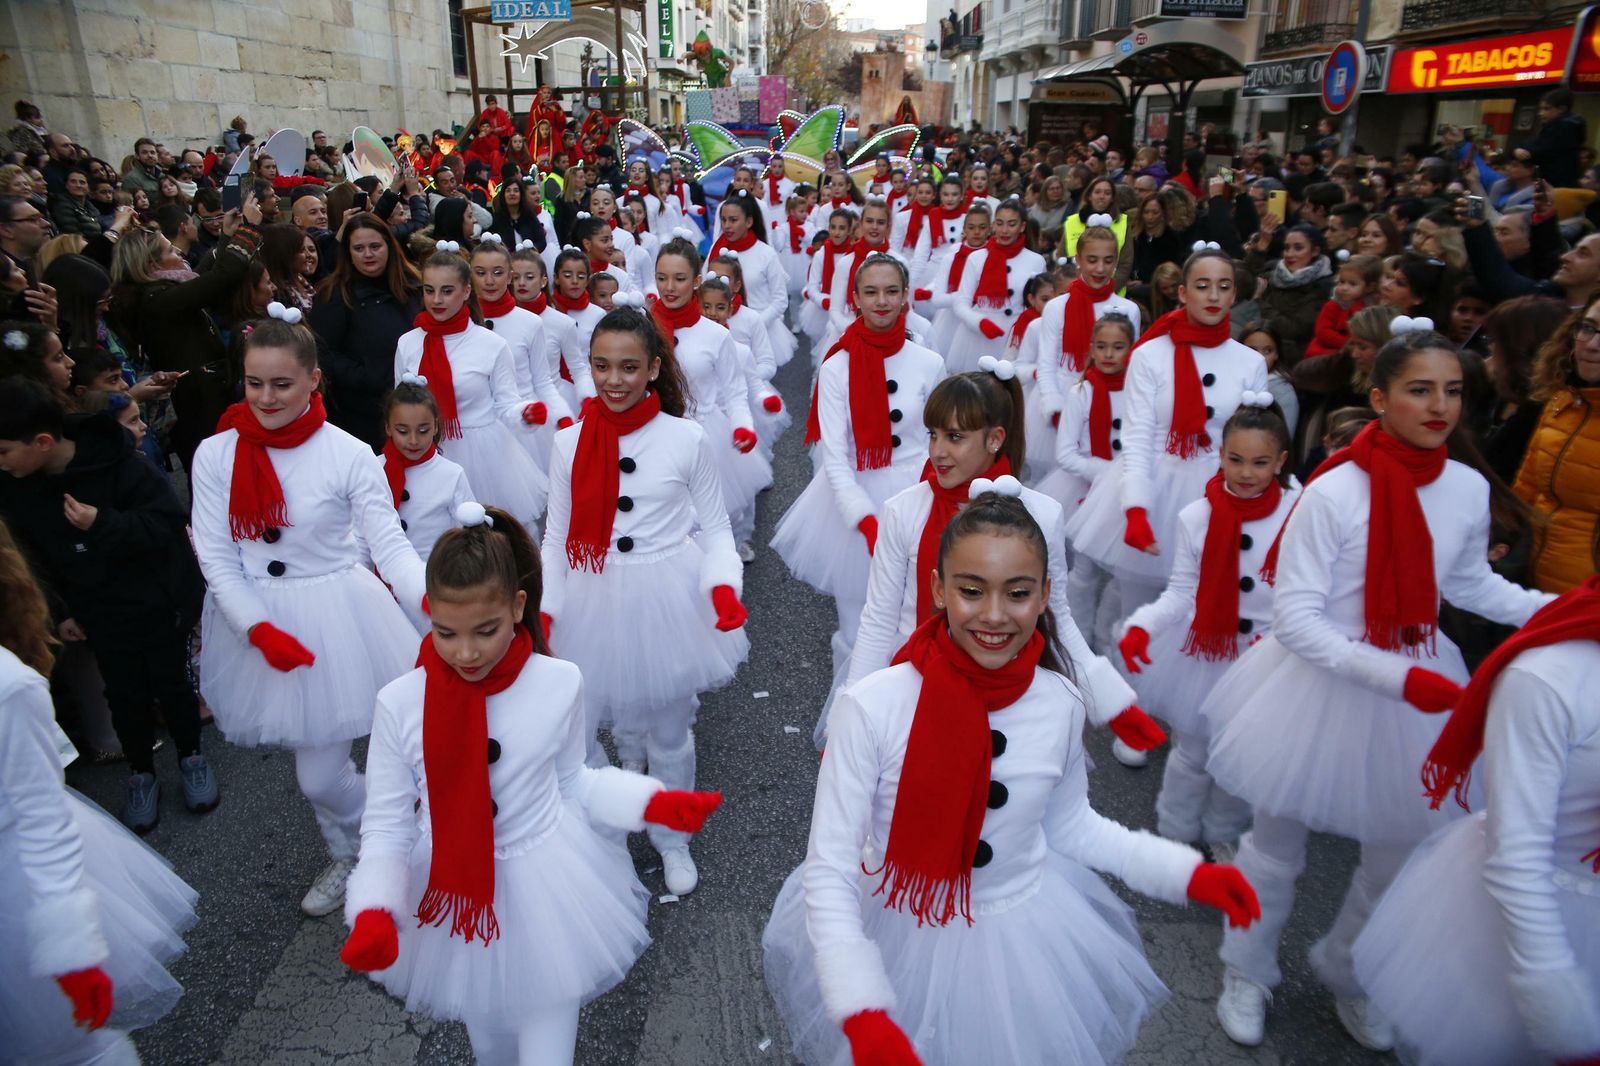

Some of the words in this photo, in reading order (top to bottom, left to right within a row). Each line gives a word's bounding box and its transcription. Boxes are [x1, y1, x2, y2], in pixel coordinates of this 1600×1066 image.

[494, 1, 567, 17] IDEAL
[1447, 42, 1553, 75] TABACOS
[1245, 63, 1292, 88] PIANOS
